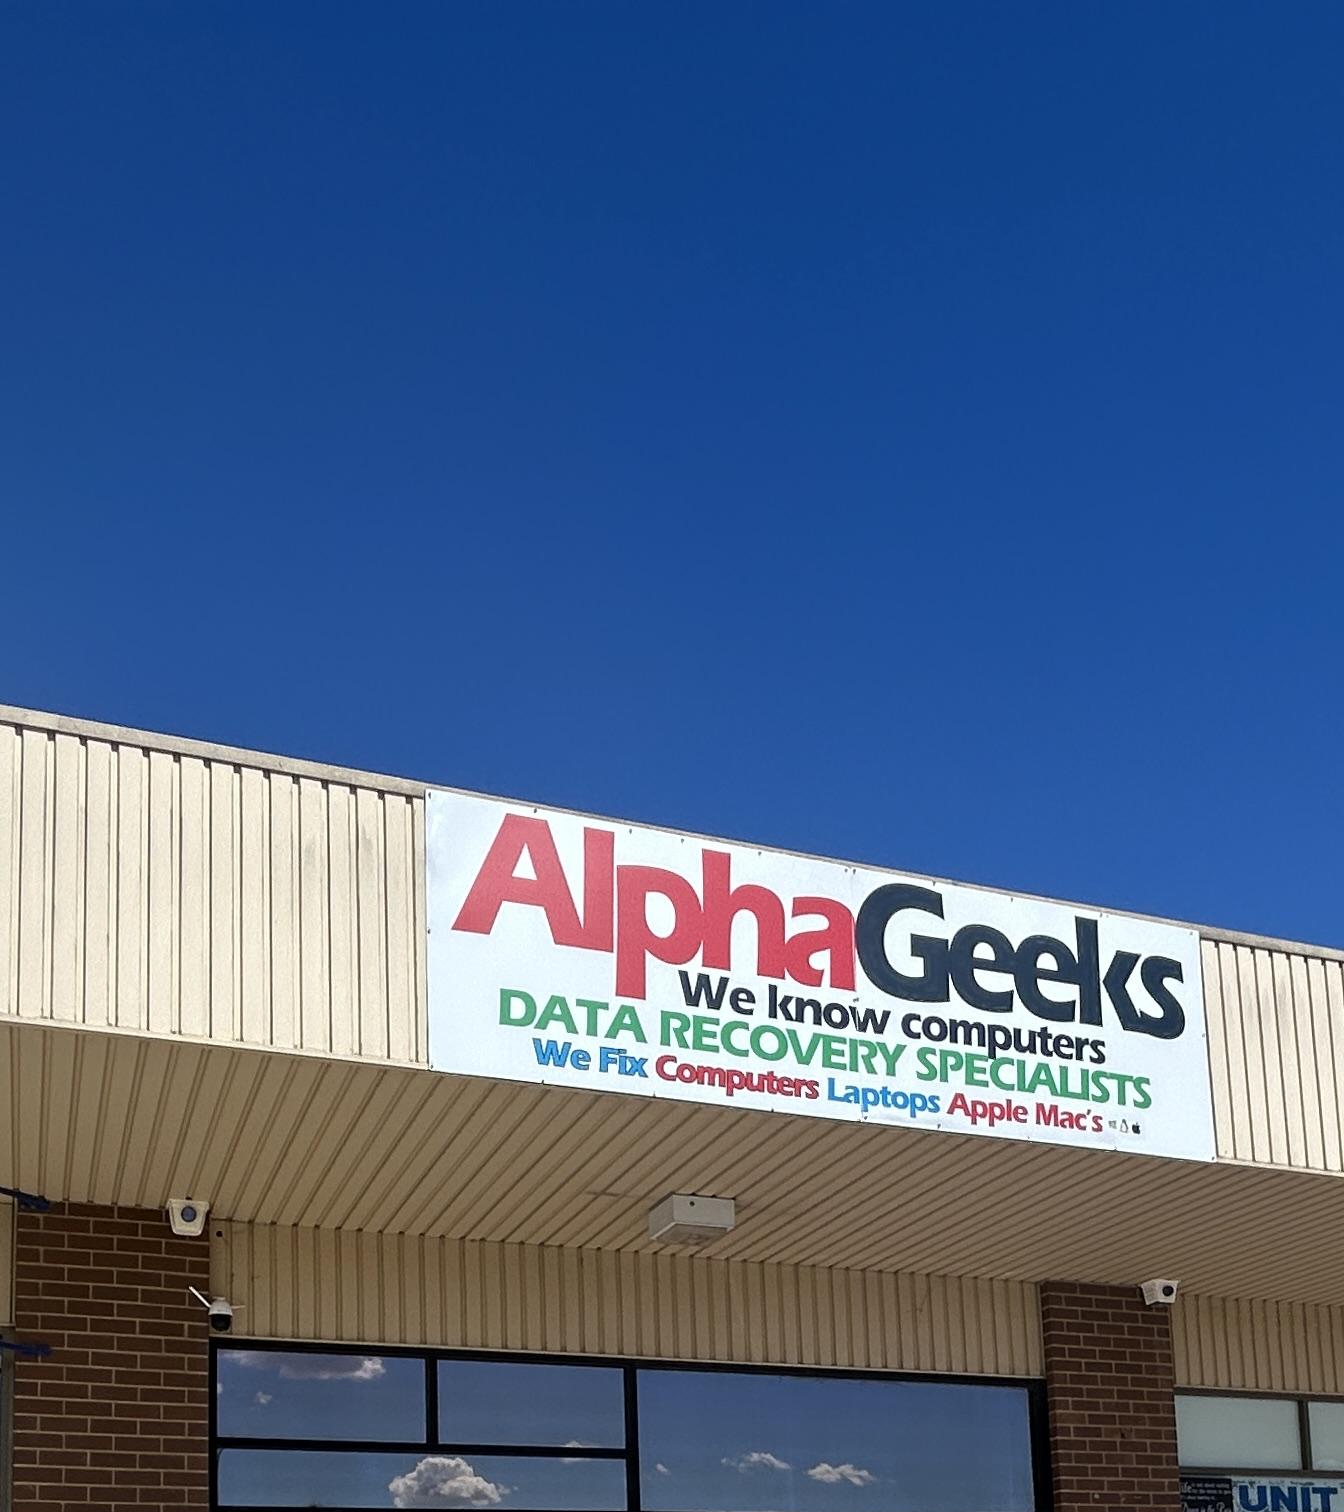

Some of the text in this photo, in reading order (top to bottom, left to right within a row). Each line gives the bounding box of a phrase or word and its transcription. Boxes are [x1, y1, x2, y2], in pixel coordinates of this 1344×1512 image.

[452, 813, 1185, 1040] AlphaGeeks
[499, 987, 1153, 1110] DATA RECOVERY SPECIALISTS
[678, 969, 1107, 1066] We know computers
[532, 1036, 1104, 1134] We Fix Computers Laptops Apple Mac's
